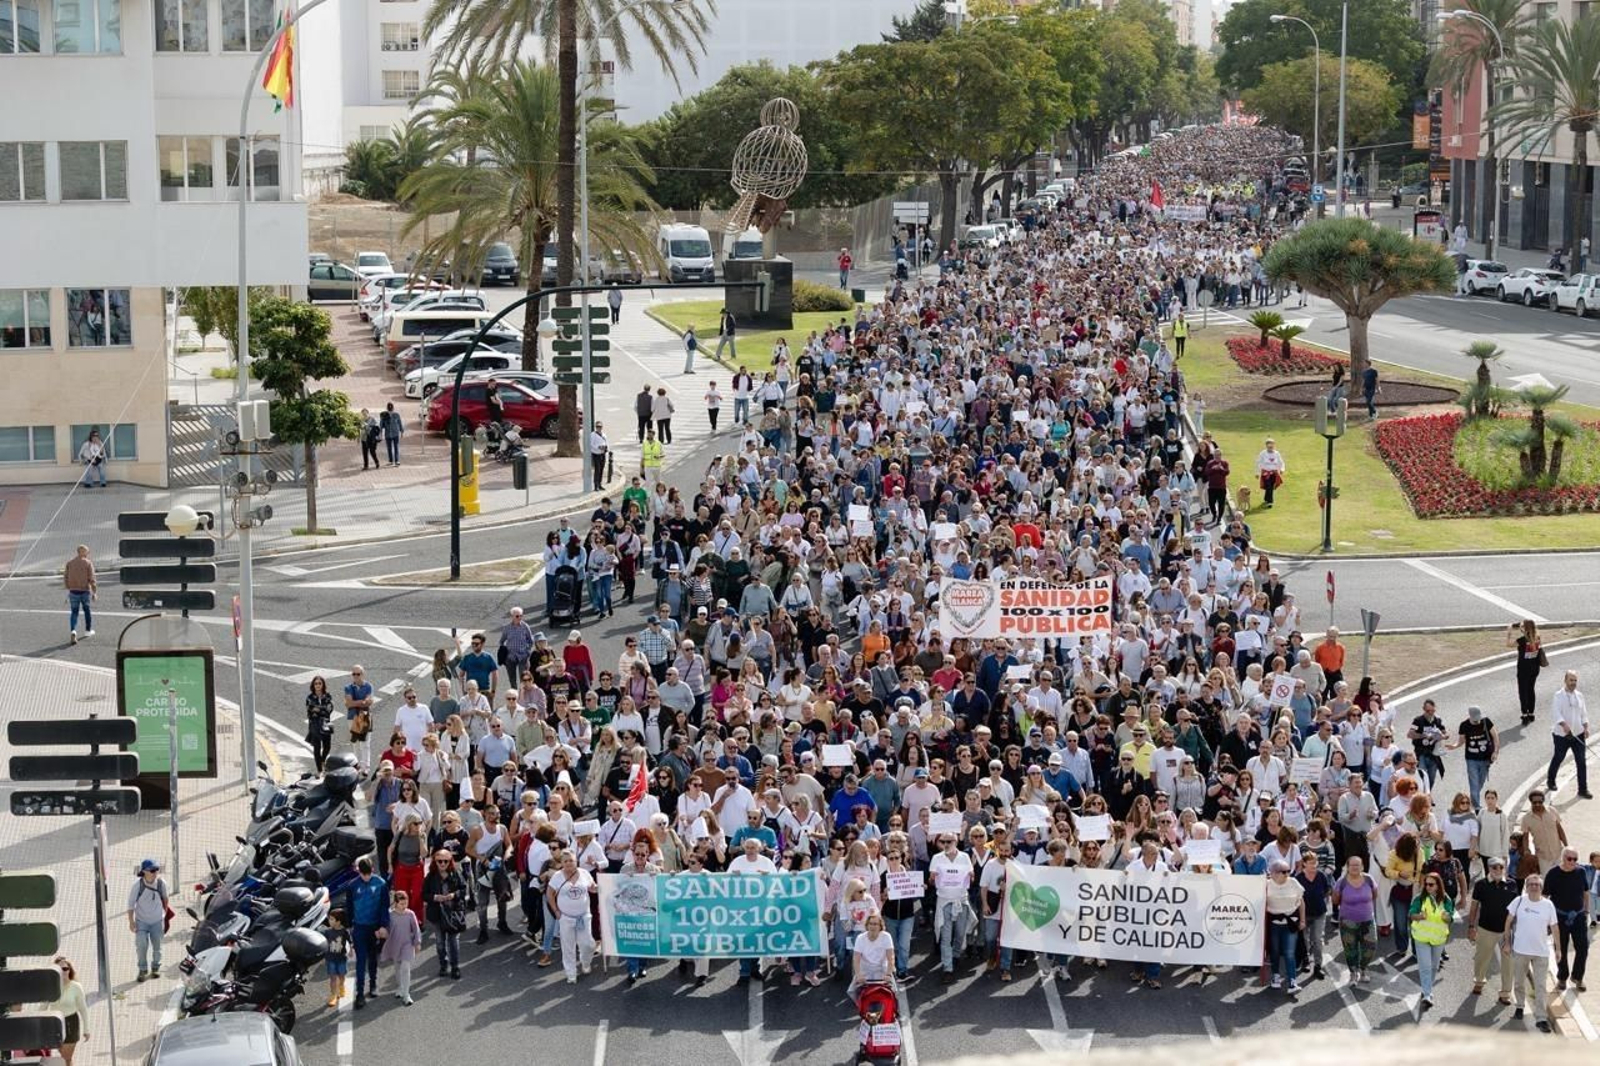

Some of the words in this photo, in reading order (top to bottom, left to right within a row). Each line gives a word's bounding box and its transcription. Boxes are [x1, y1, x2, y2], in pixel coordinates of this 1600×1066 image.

[1000, 581, 1015, 590] EN
[1020, 580, 1072, 590] DEFEN
[1095, 580, 1108, 589] LA
[1000, 589, 1109, 606] SANIDAD
[1000, 607, 1044, 616] 100
[1066, 605, 1109, 616] 100
[1000, 613, 1109, 634] PÚBLICA
[665, 876, 811, 899] SANIDAD
[1078, 882, 1189, 904] SANIDAD
[676, 905, 802, 927] 100x100
[1078, 905, 1188, 927] PÚBLICA
[1211, 905, 1250, 913] MAREA
[617, 922, 655, 930] mareas
[618, 930, 655, 940] blancas
[1058, 924, 1072, 939] Y
[1078, 926, 1107, 943] DE
[1112, 927, 1205, 949] CALIDAD
[669, 928, 812, 954] PÚBLICA
